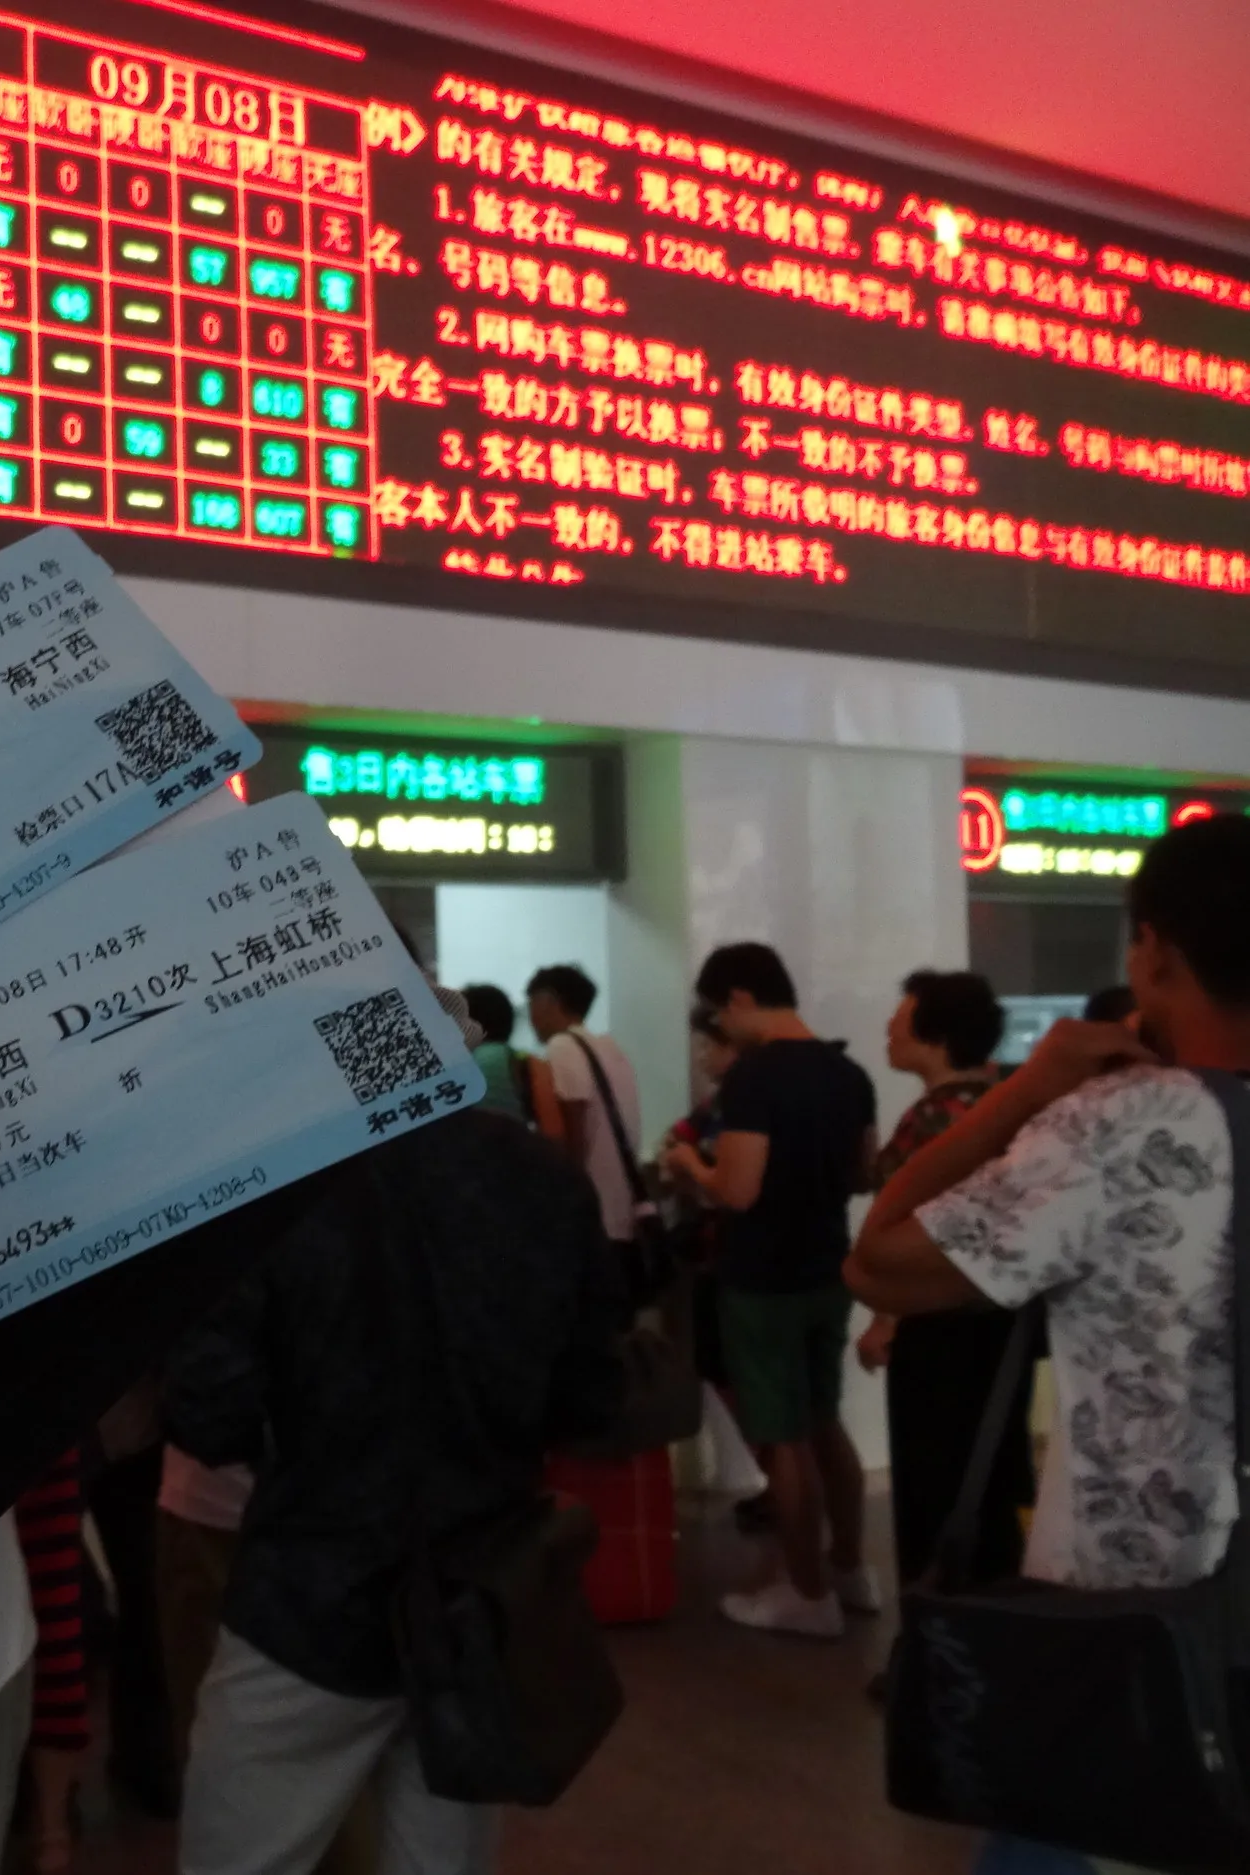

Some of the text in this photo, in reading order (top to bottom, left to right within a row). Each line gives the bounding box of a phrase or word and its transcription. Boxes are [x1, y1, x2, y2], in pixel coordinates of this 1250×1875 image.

[89, 53, 306, 147] 09月08日
[58, 163, 79, 193] 0
[130, 178, 150, 208] 0
[265, 208, 284, 236] 0
[201, 315, 221, 342] 0
[267, 327, 286, 354] 0
[63, 415, 83, 445] 0
[0, 627, 98, 696] 海宁西
[155, 749, 242, 809] 和谐号
[49, 963, 199, 1041] D3210次
[210, 906, 343, 987] 上海虹桥
[55, 922, 148, 982] 17:48开
[204, 933, 384, 1016] ShangHaiHongQiao
[366, 1079, 467, 1136] 和谐号
